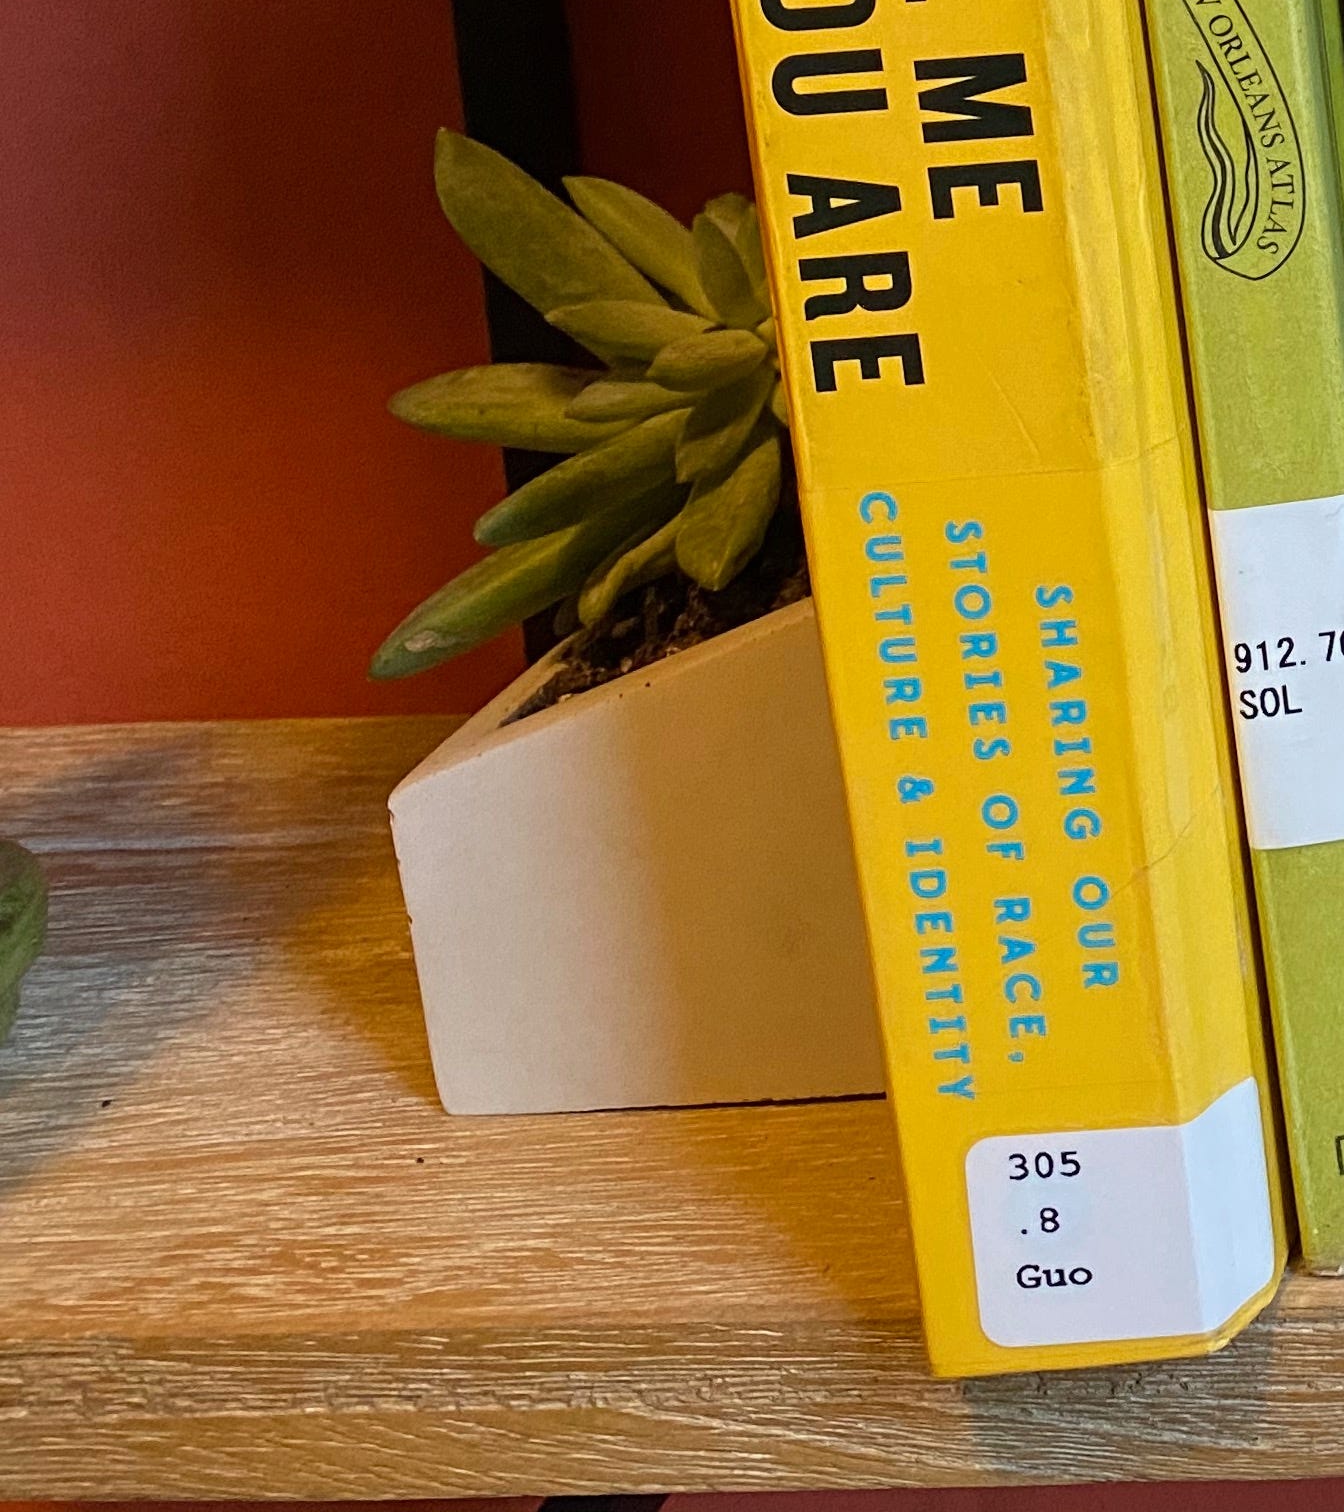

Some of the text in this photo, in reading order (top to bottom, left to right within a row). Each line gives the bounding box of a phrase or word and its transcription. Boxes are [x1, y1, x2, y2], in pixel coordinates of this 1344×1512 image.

[913, 51, 1045, 222] ME
[1209, 14, 1285, 150] ORLEANS
[1256, 155, 1295, 255] ATLAS
[786, 171, 927, 395] ARE
[944, 518, 1012, 760] STORIES
[980, 791, 1025, 862] OF
[1036, 583, 1120, 990] SHARING OUR
[1239, 684, 1303, 720] SOL
[858, 490, 976, 1102] CULTURE & IDENTITY
[1007, 1149, 1082, 1182] 305
[1021, 1206, 1061, 1235] .8
[1015, 1262, 1094, 1290] Guo
